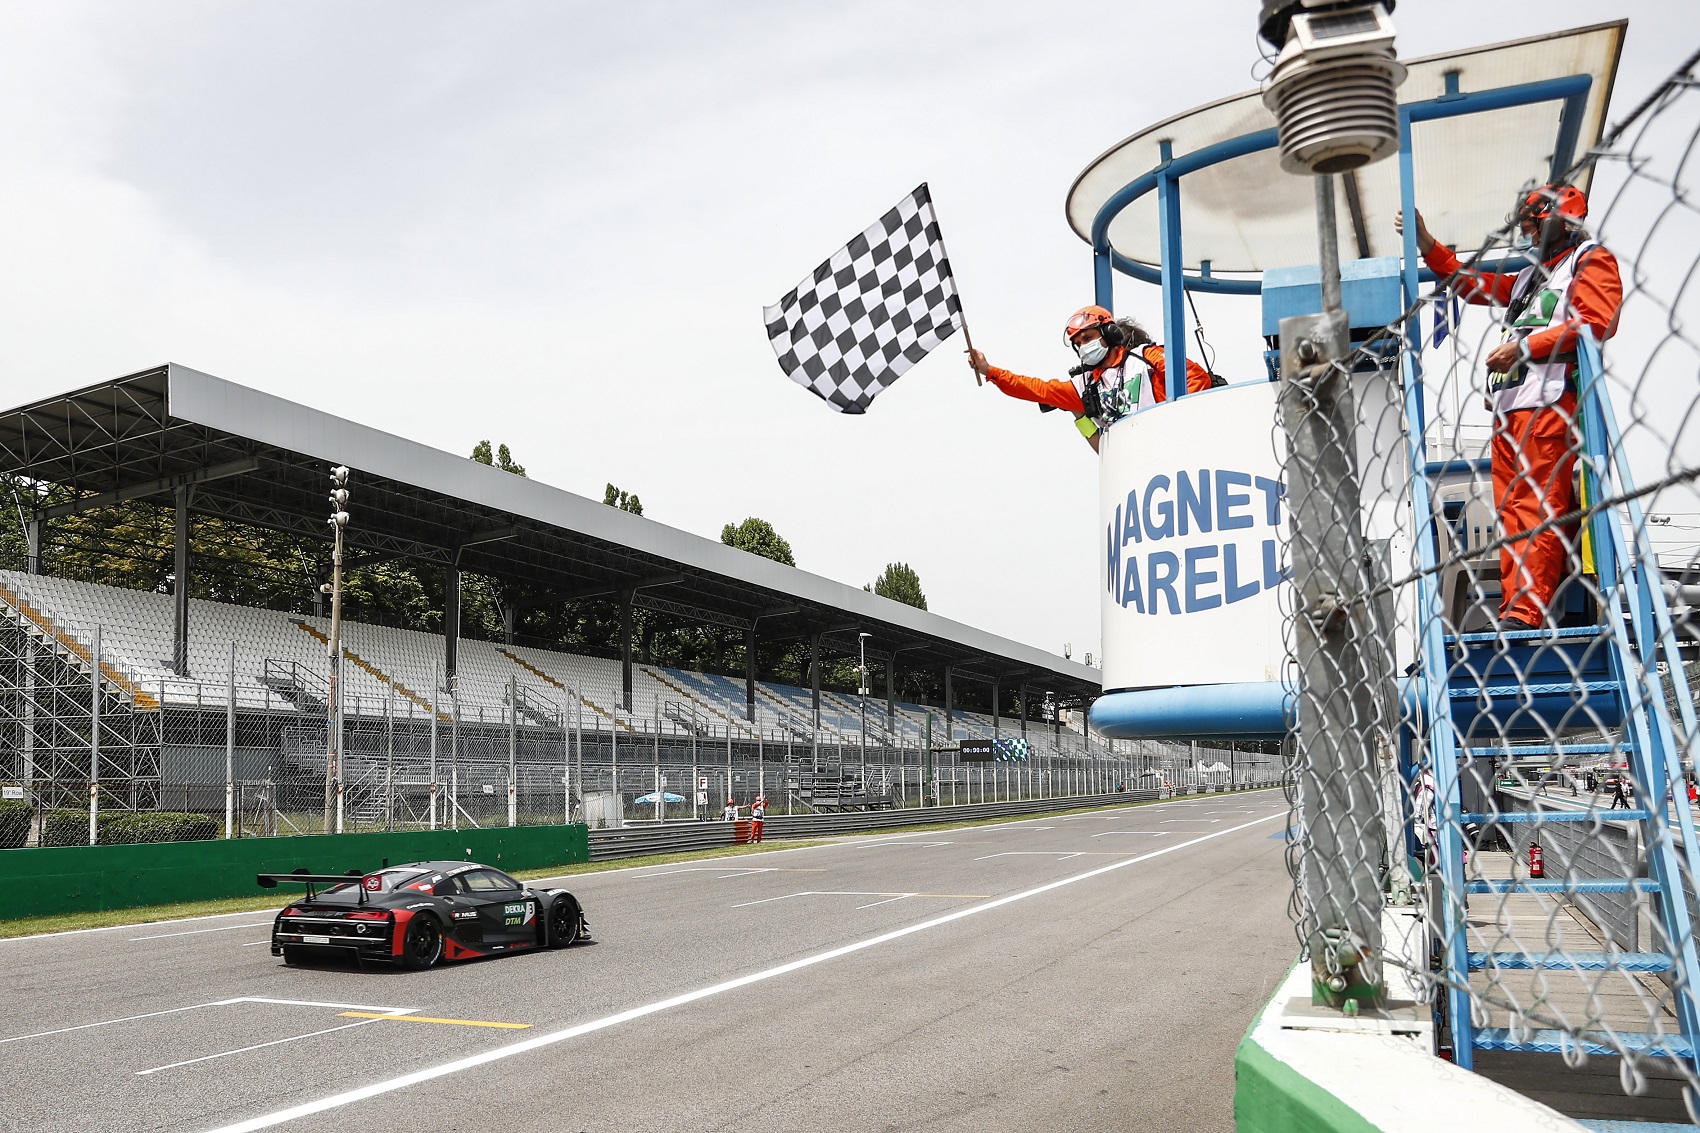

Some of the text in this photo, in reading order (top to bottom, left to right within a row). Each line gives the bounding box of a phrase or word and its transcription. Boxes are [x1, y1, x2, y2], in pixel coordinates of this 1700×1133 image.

[700, 778, 706, 788] F
[504, 904, 526, 914] DEKRA
[529, 903, 534, 915] 3
[505, 917, 521, 926] DTM
